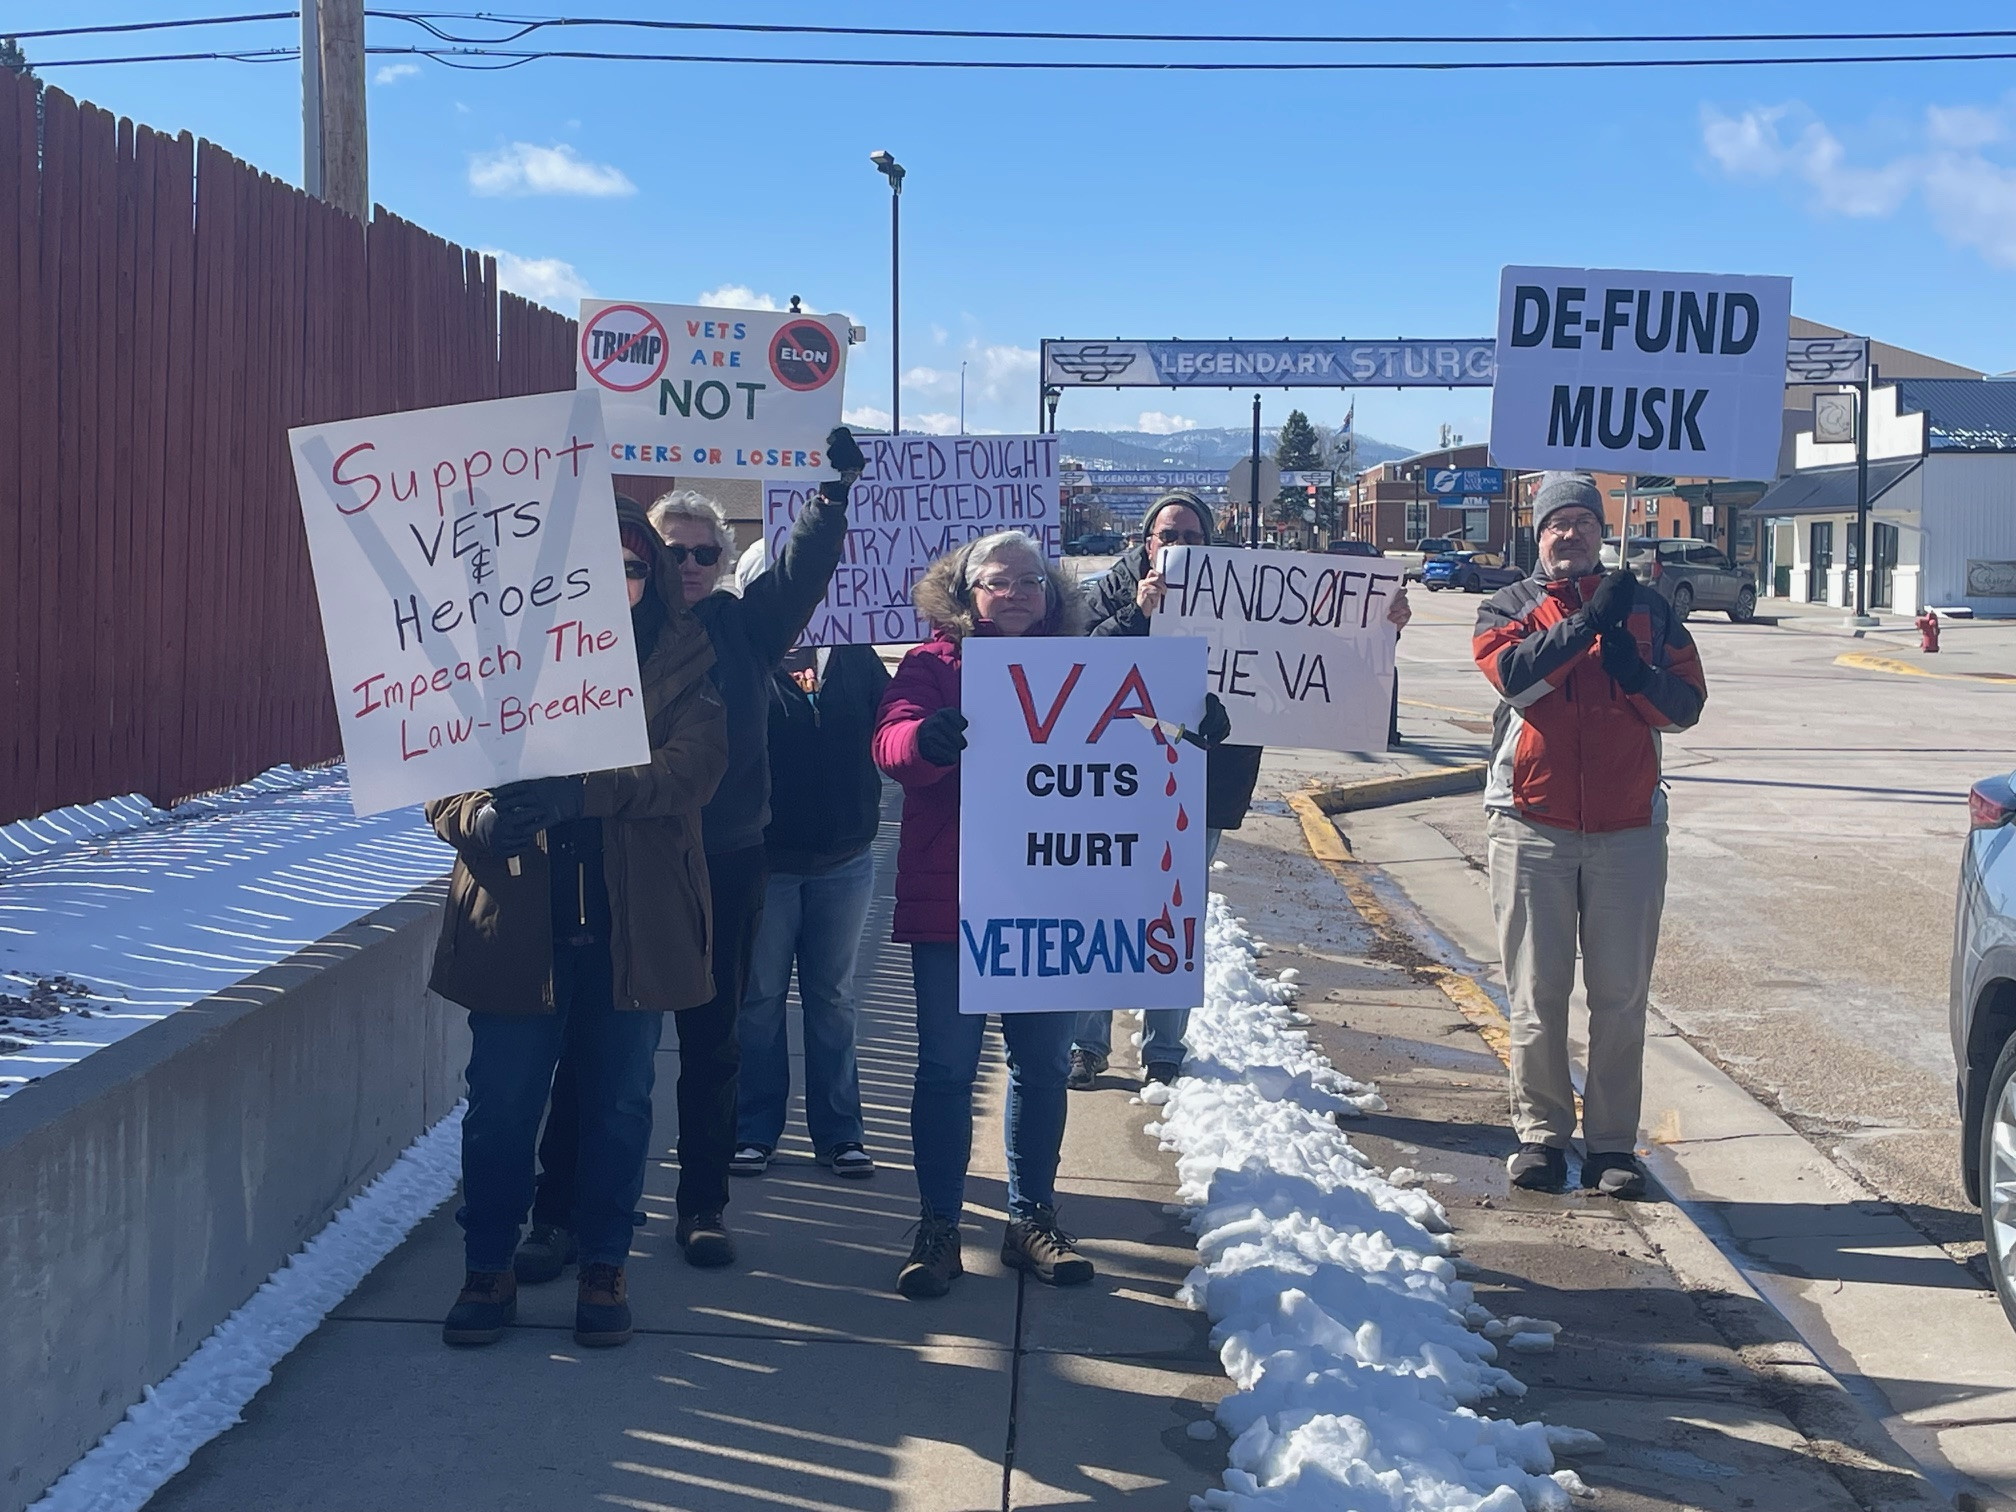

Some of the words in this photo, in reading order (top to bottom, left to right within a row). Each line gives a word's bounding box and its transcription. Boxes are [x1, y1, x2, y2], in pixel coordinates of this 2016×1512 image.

[687, 320, 746, 340] VETS
[1510, 285, 1759, 355] DE-FUND
[591, 329, 661, 365] TRUMP
[691, 350, 741, 367] ARE
[781, 347, 828, 364] ELON
[1161, 352, 1336, 375] LEGENDARY
[1351, 347, 1493, 378] STURG
[659, 379, 766, 420] NOT
[1547, 384, 1709, 451] MUSK
[332, 436, 594, 515] Support
[611, 443, 682, 463] CKERS
[694, 448, 722, 465] OR
[736, 449, 821, 467] LOSERS
[856, 440, 946, 481] ERVED
[954, 438, 1057, 480] FOUGHT
[1158, 472, 1221, 484] STURGIS
[854, 482, 992, 522] PROTECTED
[993, 483, 1046, 519] THIS
[410, 501, 540, 566] VETS
[394, 568, 590, 650] Heroes
[862, 609, 904, 643] TO
[353, 644, 521, 718] Impeach
[546, 621, 618, 662] The
[1207, 646, 1258, 697] HE
[1276, 650, 1331, 703] VA
[401, 680, 633, 761] Law-Breaker
[1007, 662, 1167, 745] VA
[1026, 763, 1139, 797] CUTS
[1026, 832, 1139, 867] HURT
[960, 918, 1196, 977] VETERANS!
